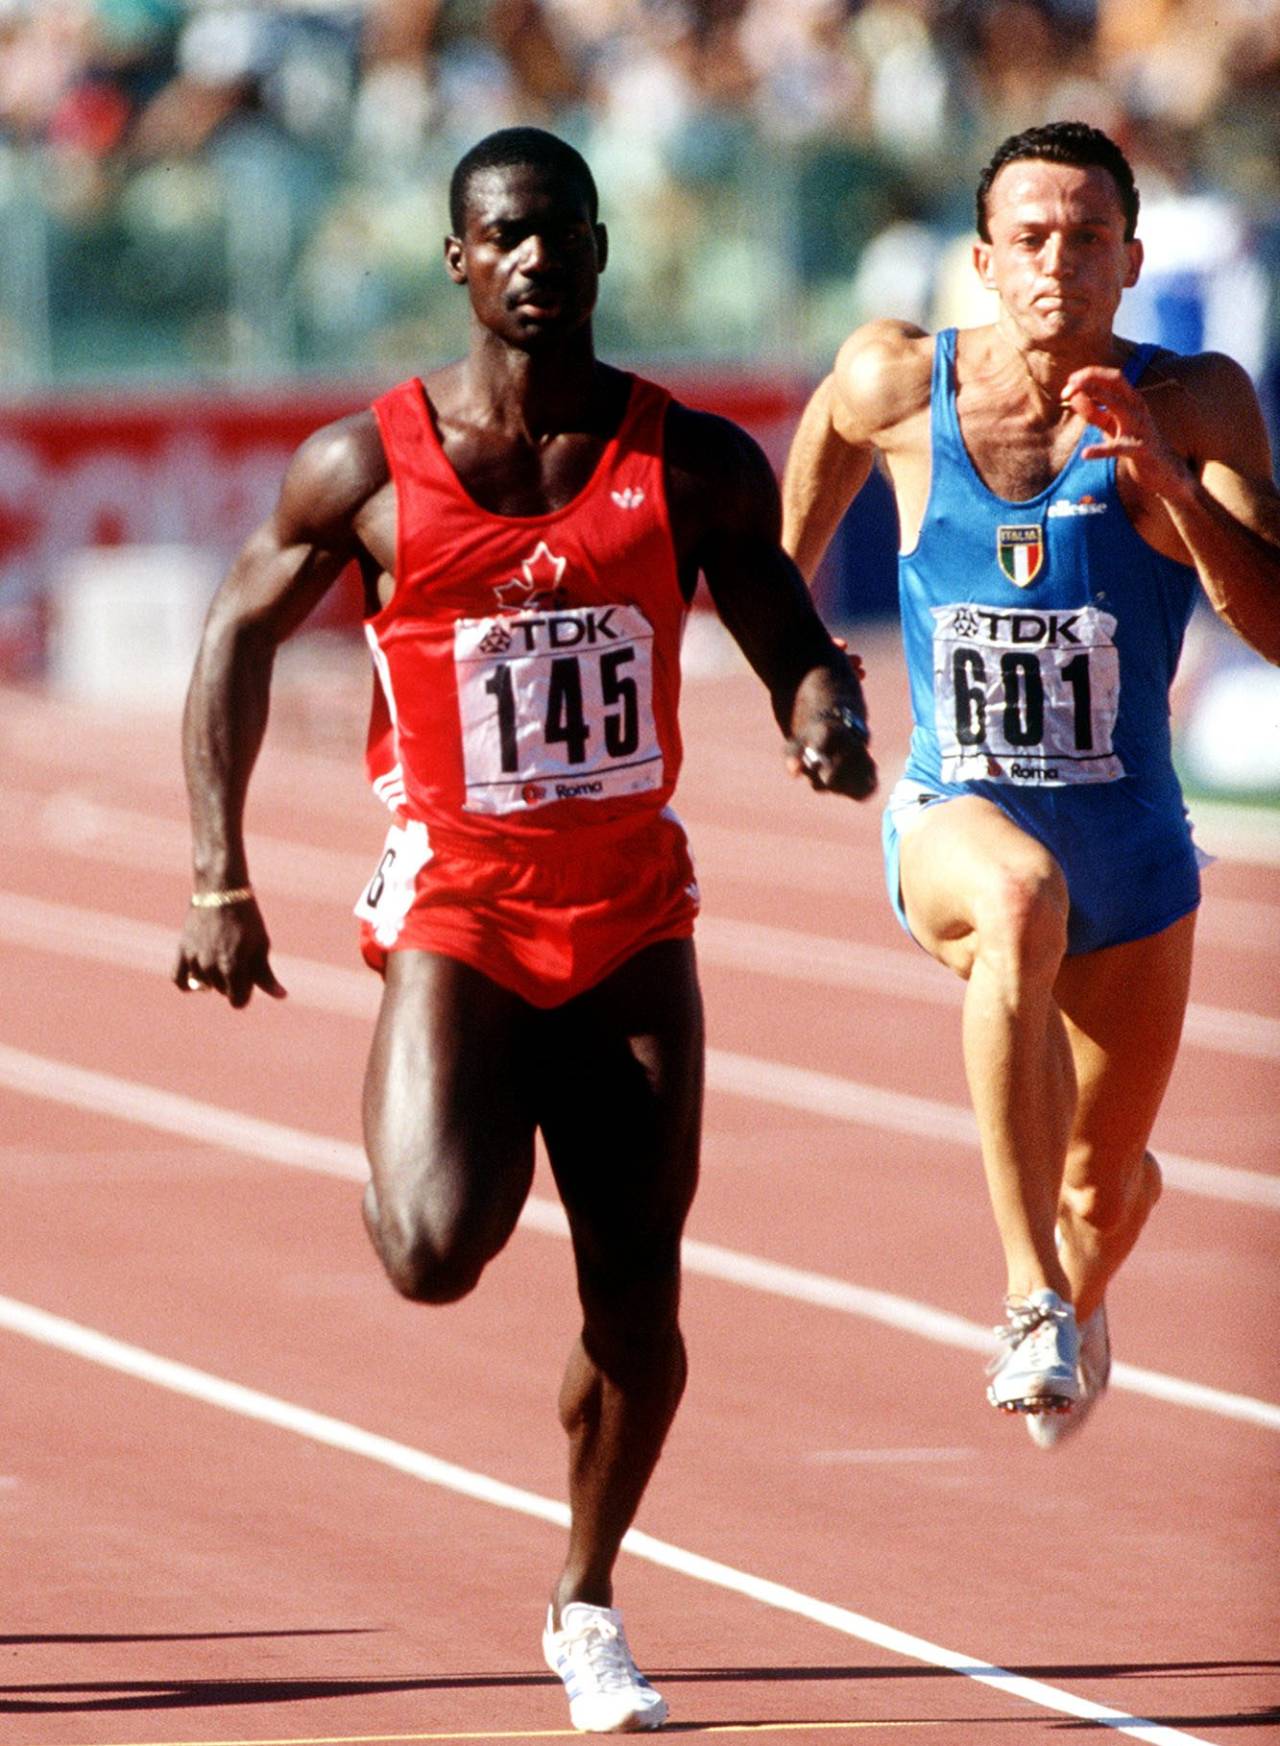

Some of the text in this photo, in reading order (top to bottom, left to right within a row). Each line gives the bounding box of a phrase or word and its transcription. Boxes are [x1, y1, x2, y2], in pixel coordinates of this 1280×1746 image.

[1000, 529, 1039, 542] ITALIA
[510, 608, 618, 650] TDK
[978, 613, 1081, 643] TDK
[486, 647, 638, 773] 145
[953, 648, 1093, 750] 601
[1011, 763, 1058, 779] Roma
[555, 781, 603, 799] Roma
[366, 848, 396, 908] 6
